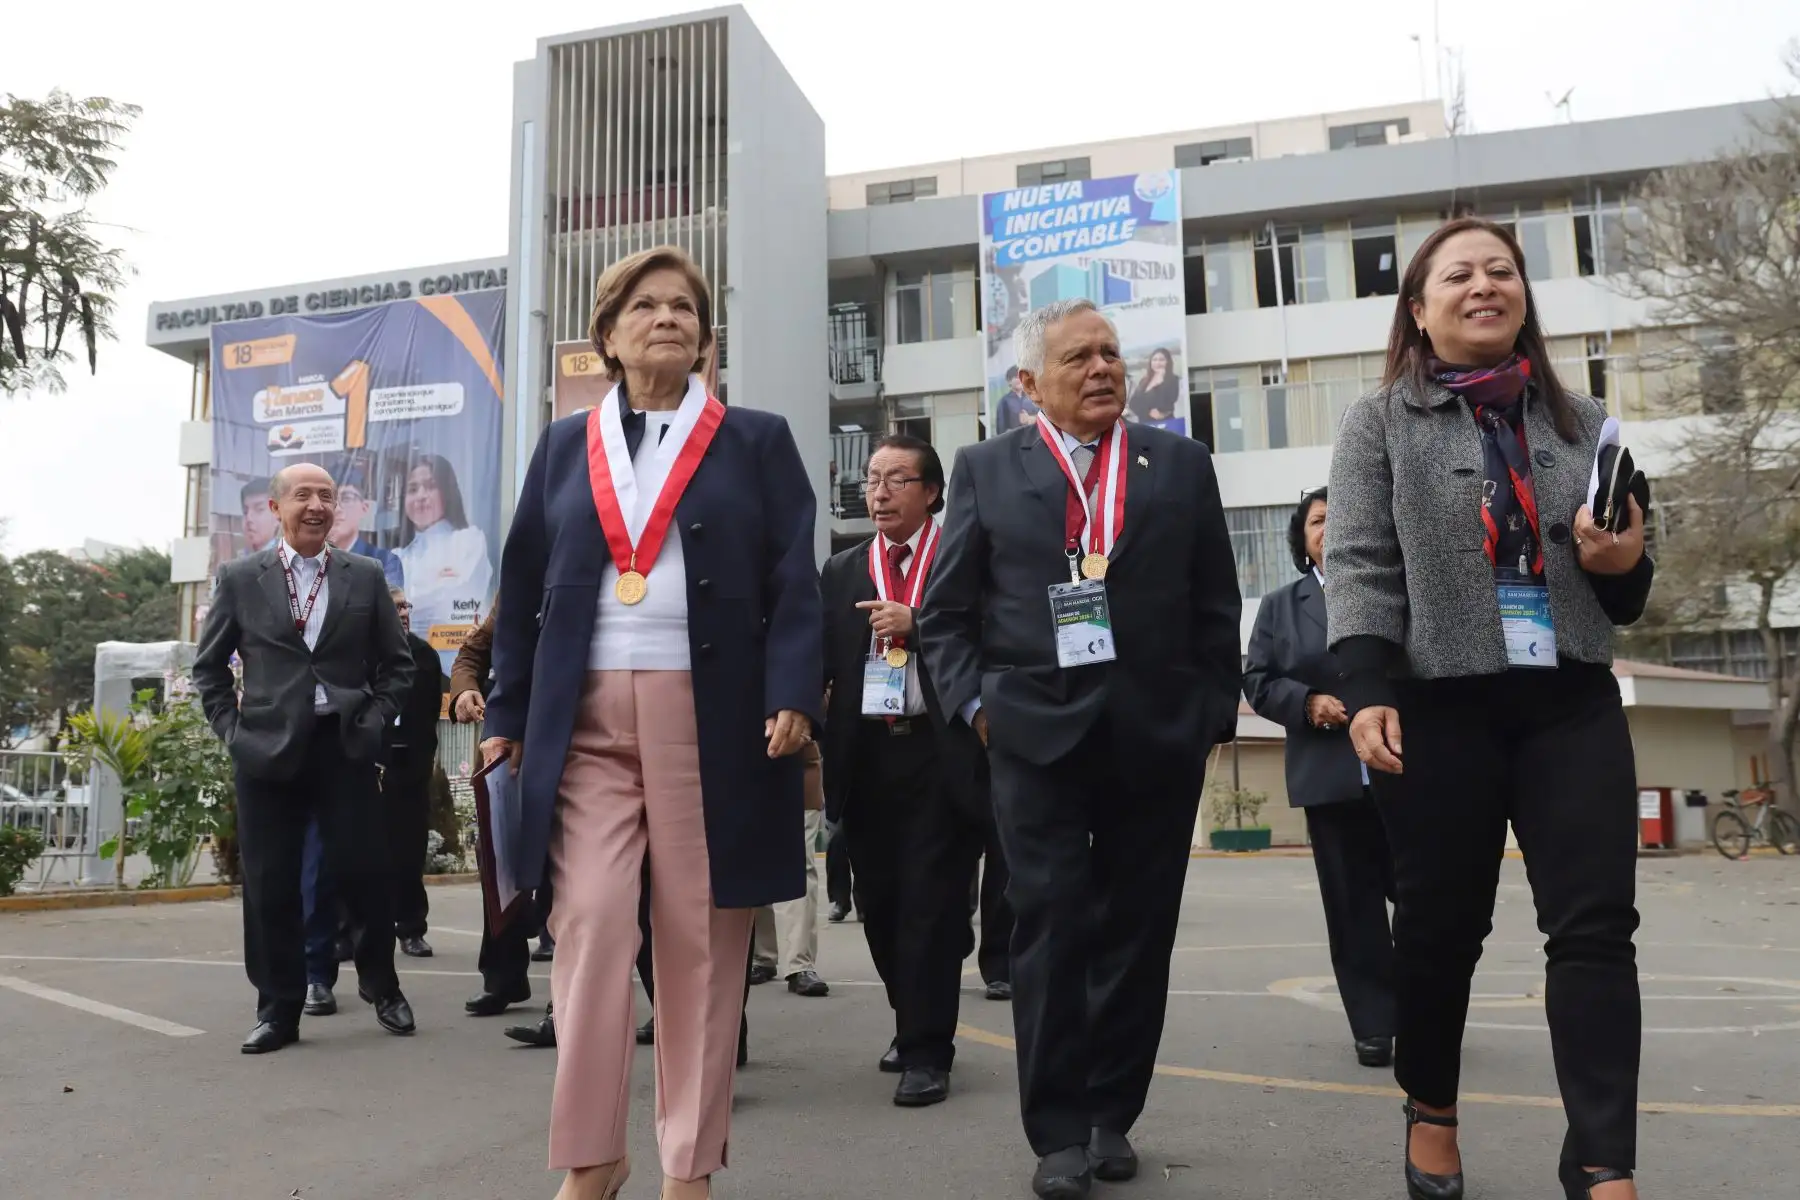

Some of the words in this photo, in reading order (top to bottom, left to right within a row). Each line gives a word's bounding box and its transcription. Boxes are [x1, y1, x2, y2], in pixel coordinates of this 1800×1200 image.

[1003, 180, 1084, 211] NUEVA
[1005, 195, 1132, 236] INICIATIVA
[1007, 218, 1139, 261] CONTABLE
[156, 300, 264, 330] FACULTAD
[269, 295, 299, 316] DE
[304, 280, 412, 312] CIENCIAS
[232, 344, 252, 365] 18
[569, 354, 588, 373] 18
[263, 407, 284, 419] San
[285, 402, 324, 417] Marcos
[329, 360, 369, 449] 1
[450, 613, 481, 621] Guerreo
[453, 598, 481, 612] Kerly
